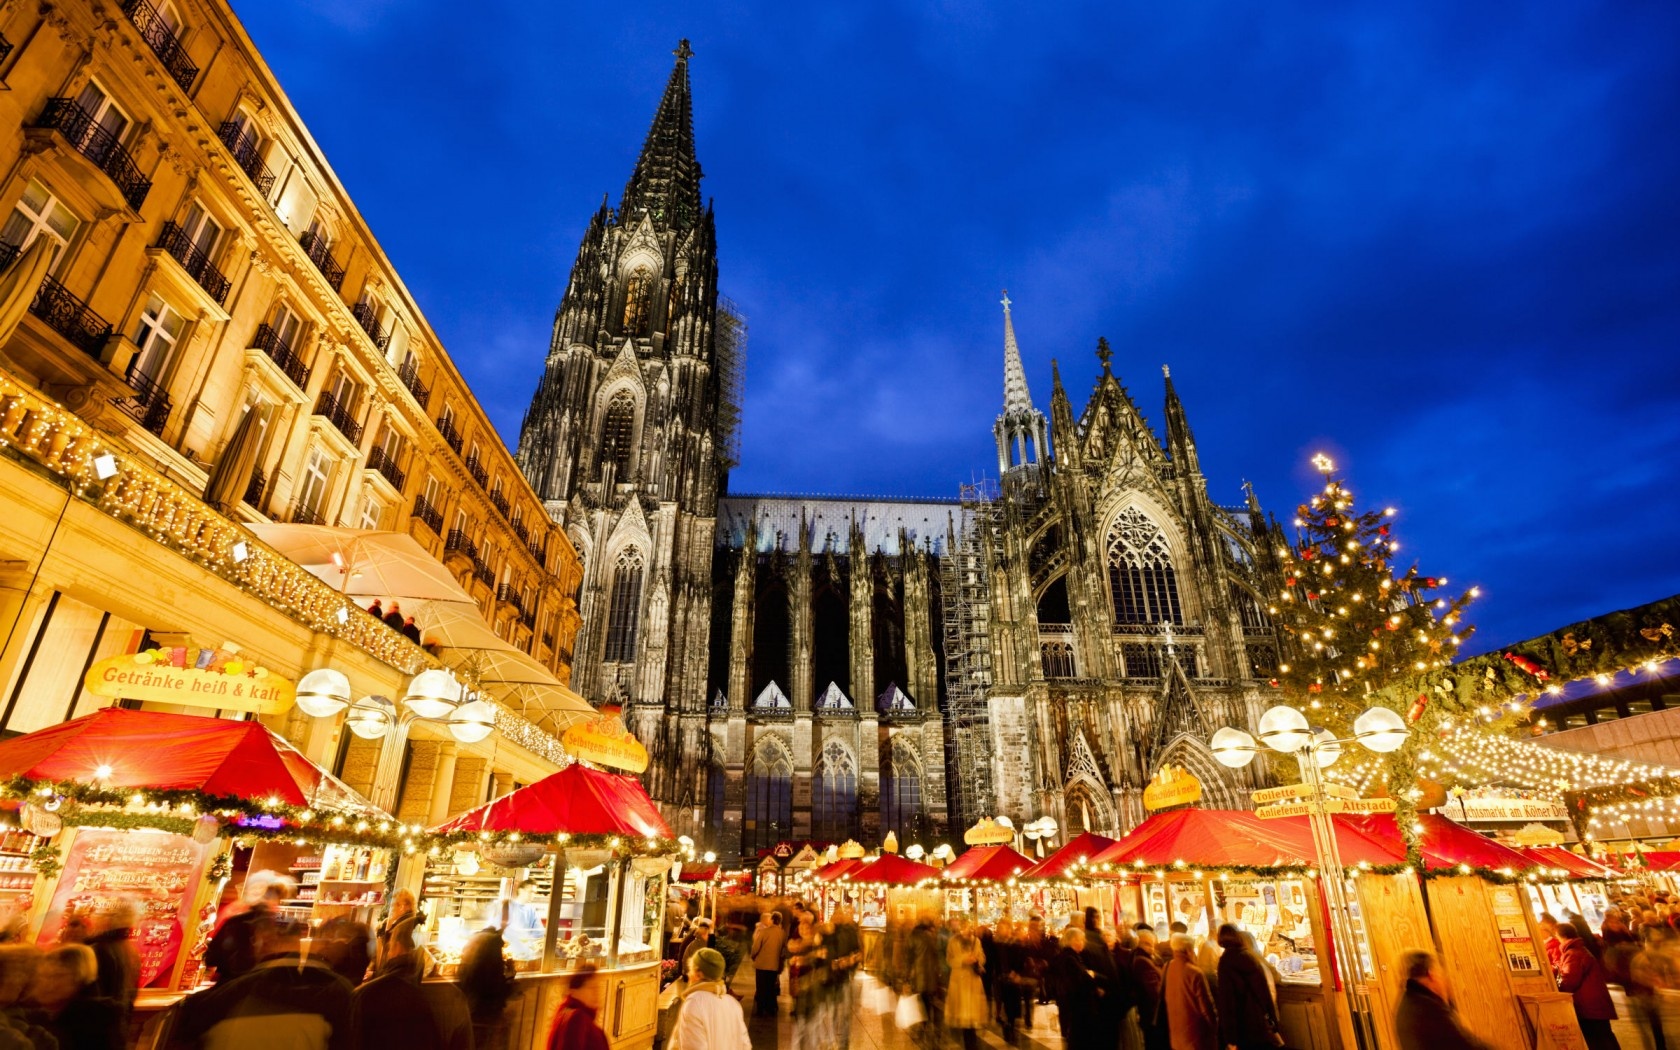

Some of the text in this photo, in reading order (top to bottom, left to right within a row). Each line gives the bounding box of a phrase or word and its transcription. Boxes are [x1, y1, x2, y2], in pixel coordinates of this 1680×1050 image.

[102, 667, 281, 701] Getränke heiß & kalt
[568, 733, 623, 757] Selbstgemachte
[1254, 788, 1296, 801] Toilette
[1259, 804, 1309, 818] Anlieferung
[1342, 801, 1393, 811] Altstadt
[1510, 808, 1524, 818] am
[1523, 804, 1552, 818] Kölner
